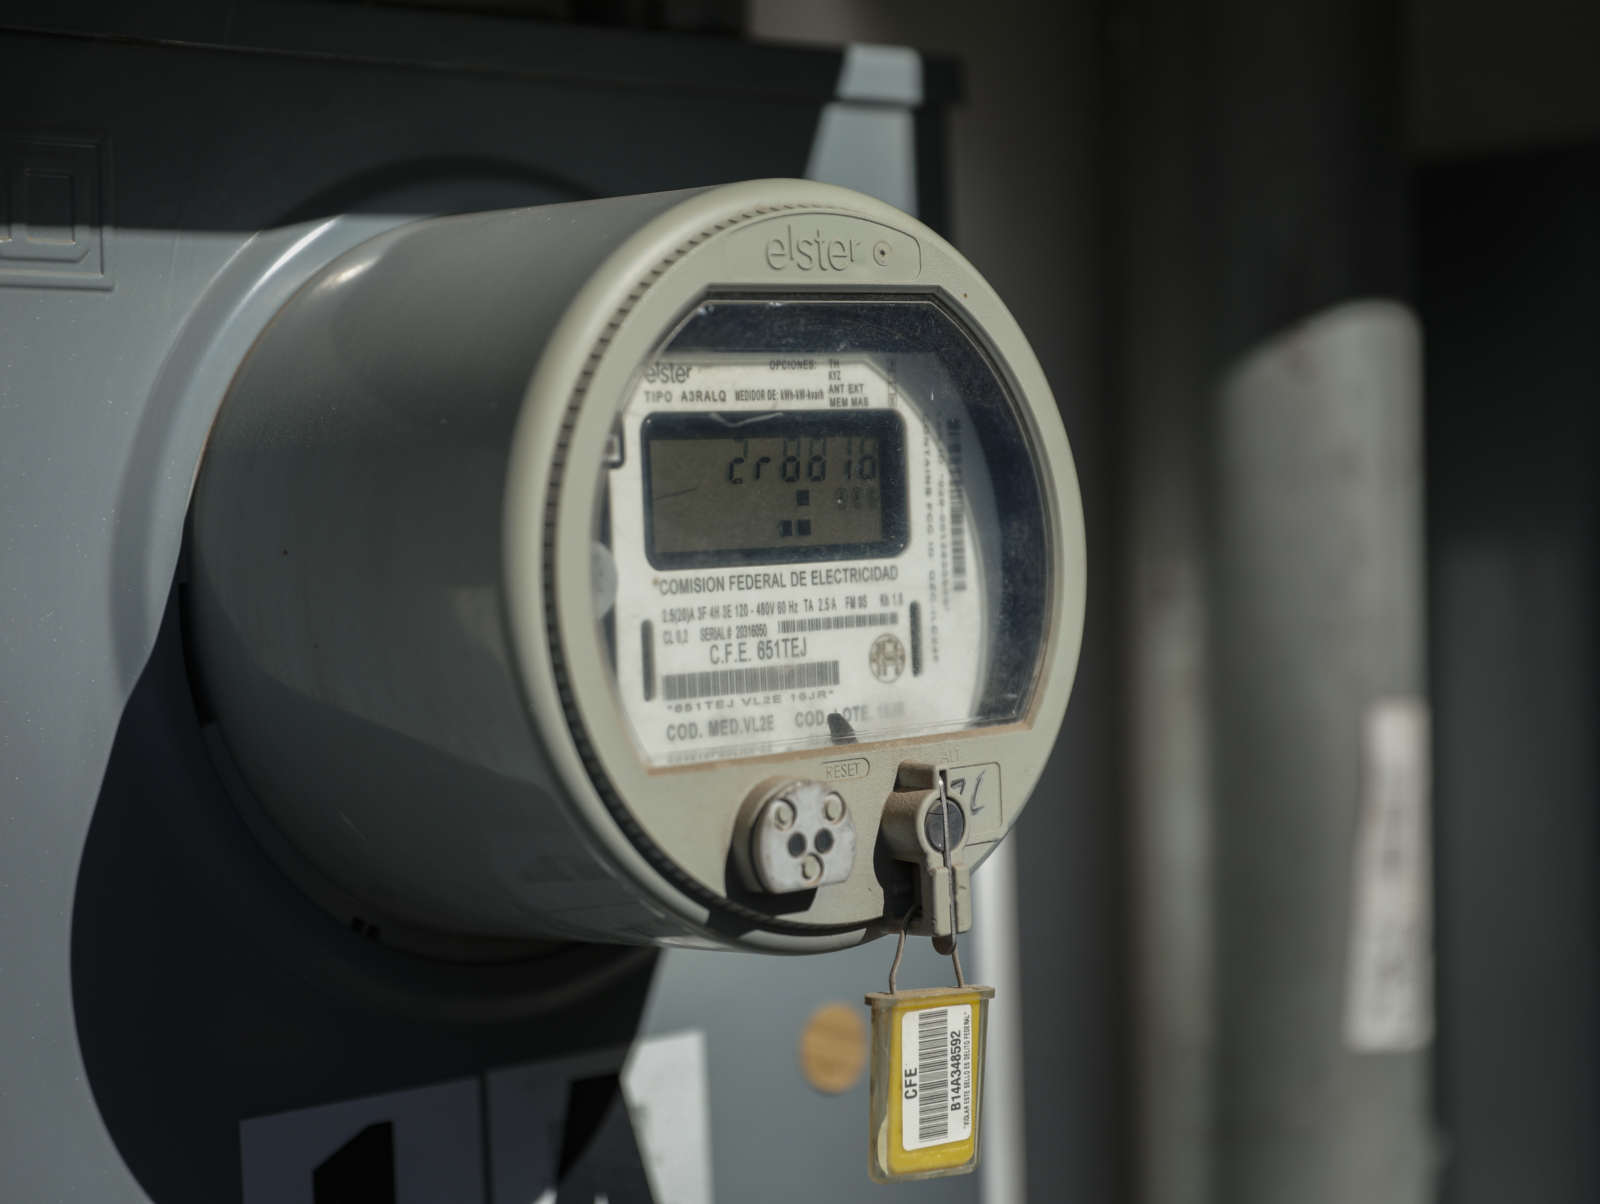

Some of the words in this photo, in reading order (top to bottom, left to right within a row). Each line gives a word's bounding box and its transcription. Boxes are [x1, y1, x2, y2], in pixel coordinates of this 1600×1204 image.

[766, 224, 860, 271] elster
[645, 362, 692, 383] elster
[769, 359, 817, 370] OPCIONES:
[829, 359, 840, 368] TH
[829, 370, 841, 381] KYZ
[644, 391, 672, 402] TIPO
[681, 390, 727, 402] A3RALQ
[735, 389, 765, 401] MEDIDOR
[767, 389, 779, 401] DE:
[829, 384, 845, 394] ANT
[848, 384, 864, 394] EXT
[830, 397, 849, 408] MEM
[851, 396, 869, 407] MAS
[659, 576, 726, 595] COMISION
[729, 572, 787, 591] FEDERAL
[790, 570, 810, 587] DE
[813, 565, 898, 586] ELECTRICIDAD
[698, 606, 707, 620] 3F
[710, 606, 720, 619] 4H
[722, 604, 732, 618] 3E
[735, 604, 748, 617] 120
[756, 602, 776, 616] 480V
[778, 601, 786, 614] 60
[788, 600, 798, 613] Hz
[804, 599, 814, 612] TA
[818, 598, 830, 611] 2.5
[845, 596, 856, 609] FM
[663, 630, 674, 645] CL
[700, 627, 726, 642] SERIAL
[727, 626, 732, 640] #
[736, 624, 768, 639] 20316050
[709, 642, 752, 665] C.F.E.
[757, 636, 807, 660] 651TEJ
[666, 722, 703, 742] COD.
[708, 714, 774, 737] MED.VL2E
[940, 750, 960, 764] ALT
[826, 762, 860, 779] RESET
[950, 1030, 962, 1111] B14A348592
[904, 1068, 918, 1100] CFE
